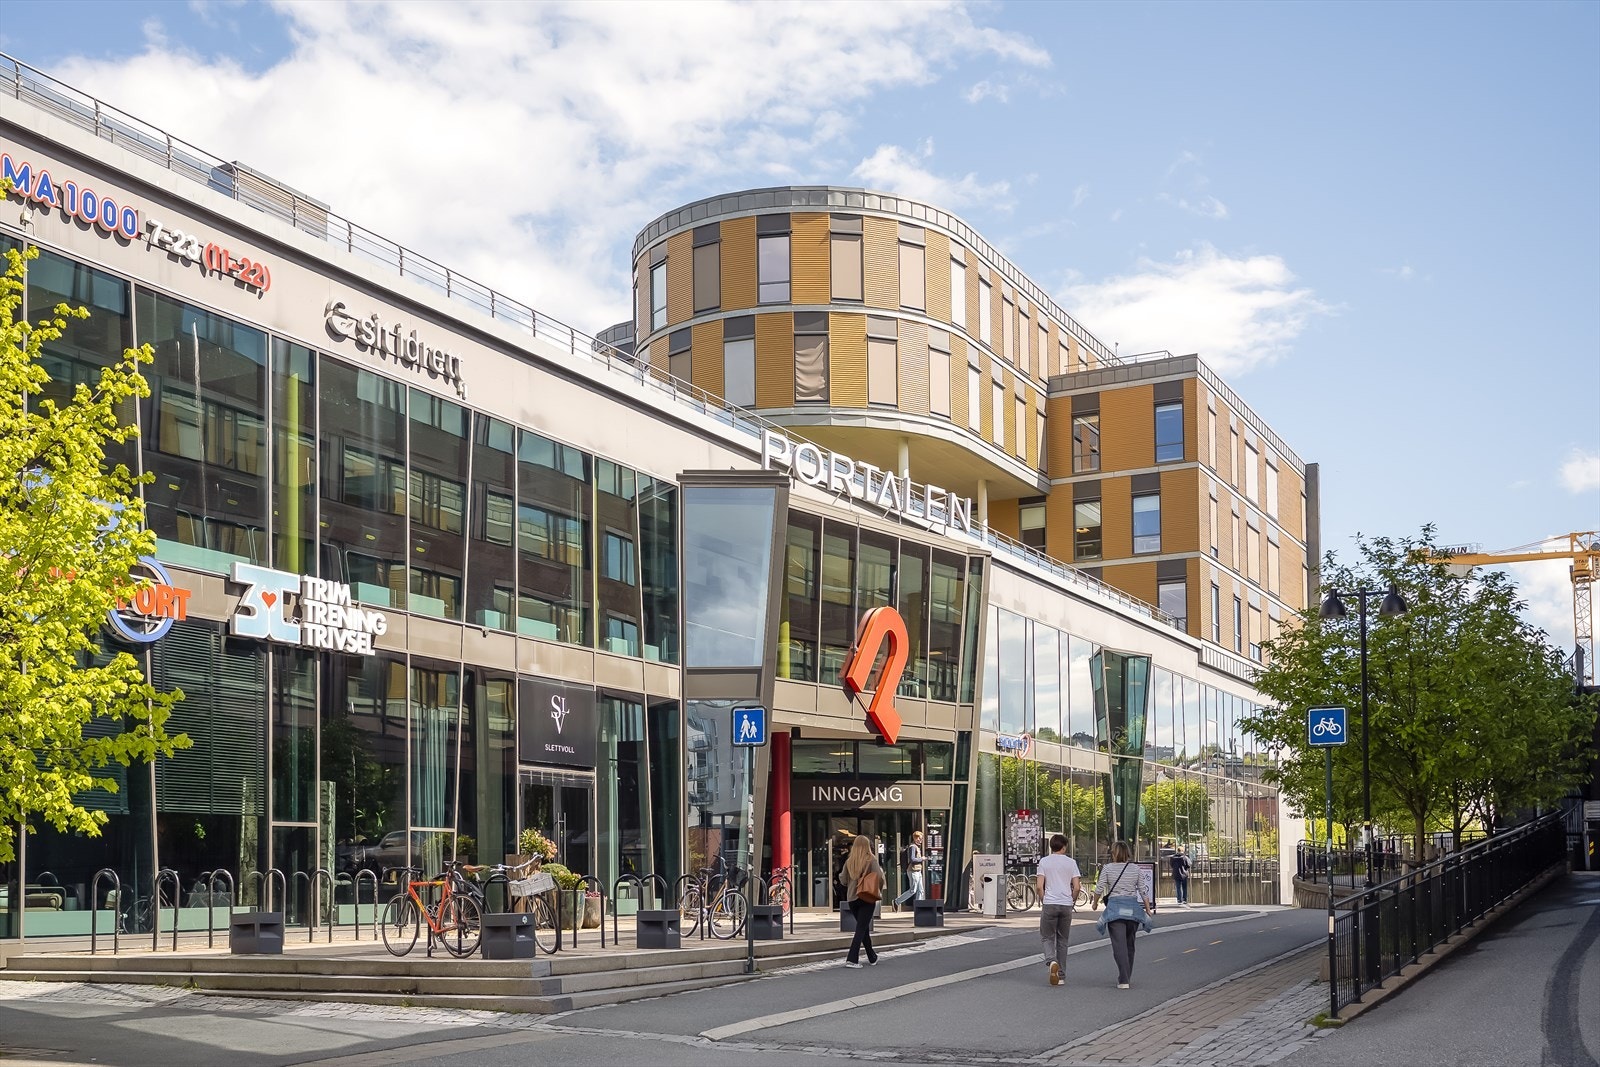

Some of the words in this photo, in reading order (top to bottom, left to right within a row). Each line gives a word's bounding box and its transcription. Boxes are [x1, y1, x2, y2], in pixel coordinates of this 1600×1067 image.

[62, 179, 139, 239] 1000
[149, 219, 200, 261] 7-23
[203, 242, 271, 292] (11-22)
[761, 429, 972, 534] PORTALEN
[301, 574, 352, 607] TRIM
[302, 599, 388, 637] TRENING
[302, 622, 376, 656] TRIVSEL
[545, 743, 575, 754] SLETTVOLL
[811, 785, 903, 803] INNGANG
